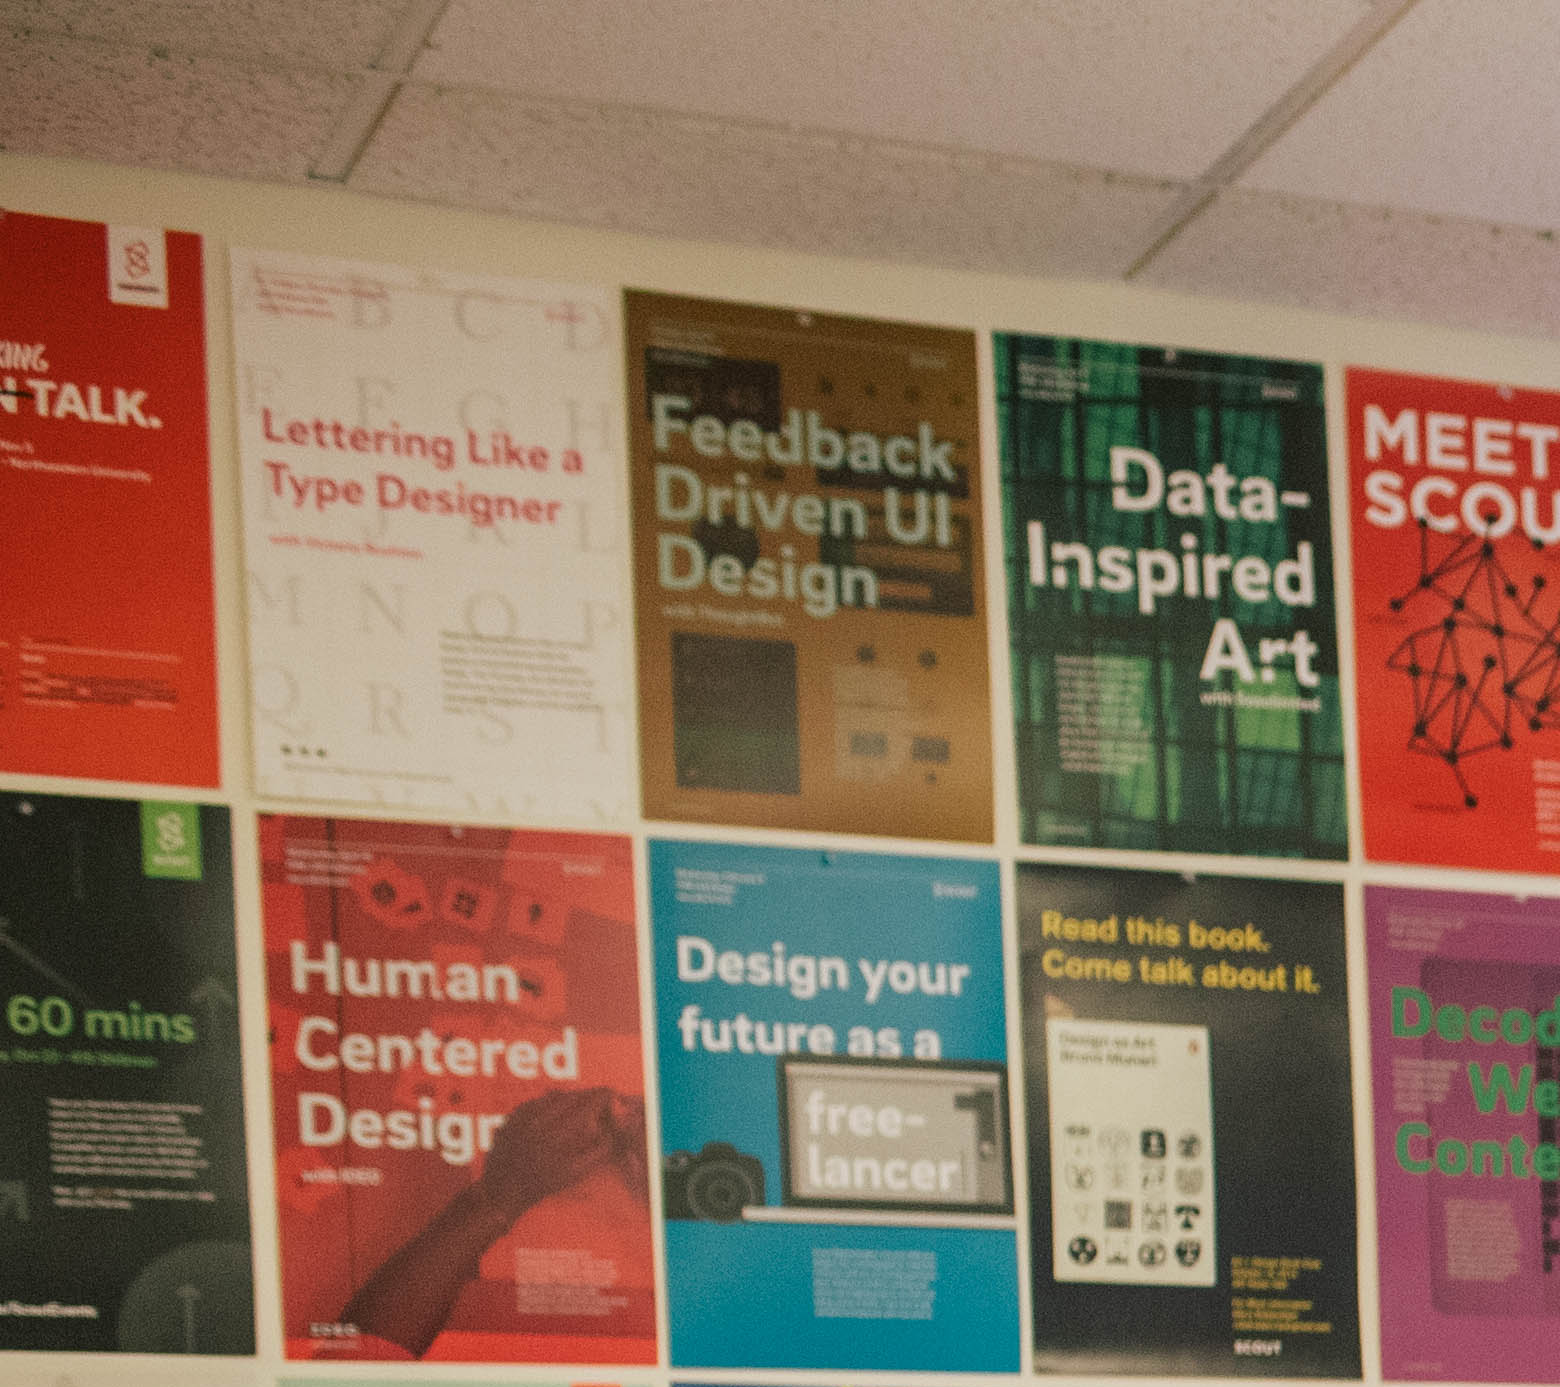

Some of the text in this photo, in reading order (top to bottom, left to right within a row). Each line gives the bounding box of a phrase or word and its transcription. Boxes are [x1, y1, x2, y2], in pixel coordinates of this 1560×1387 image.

[27, 378, 163, 429] TALK.
[262, 408, 585, 476] Lettering Like a
[652, 396, 956, 483] Feedback
[1362, 404, 1560, 480] MEET
[264, 463, 562, 526] Type Designer
[655, 463, 953, 548] Driven UI
[1110, 446, 1312, 524] Data-
[657, 535, 879, 616] Design
[1027, 519, 1316, 614] Inspired
[1199, 618, 1320, 689] Art
[1041, 909, 1271, 953] Read this book.
[290, 940, 520, 1002] Human
[676, 935, 971, 1004] Design your
[1041, 948, 1321, 994] Come talk about it.
[8, 995, 196, 1044] 60 mins
[295, 1017, 579, 1082] Centered
[678, 1004, 941, 1059] future as a
[805, 1089, 926, 1139] free-
[807, 1149, 962, 1192] lancer
